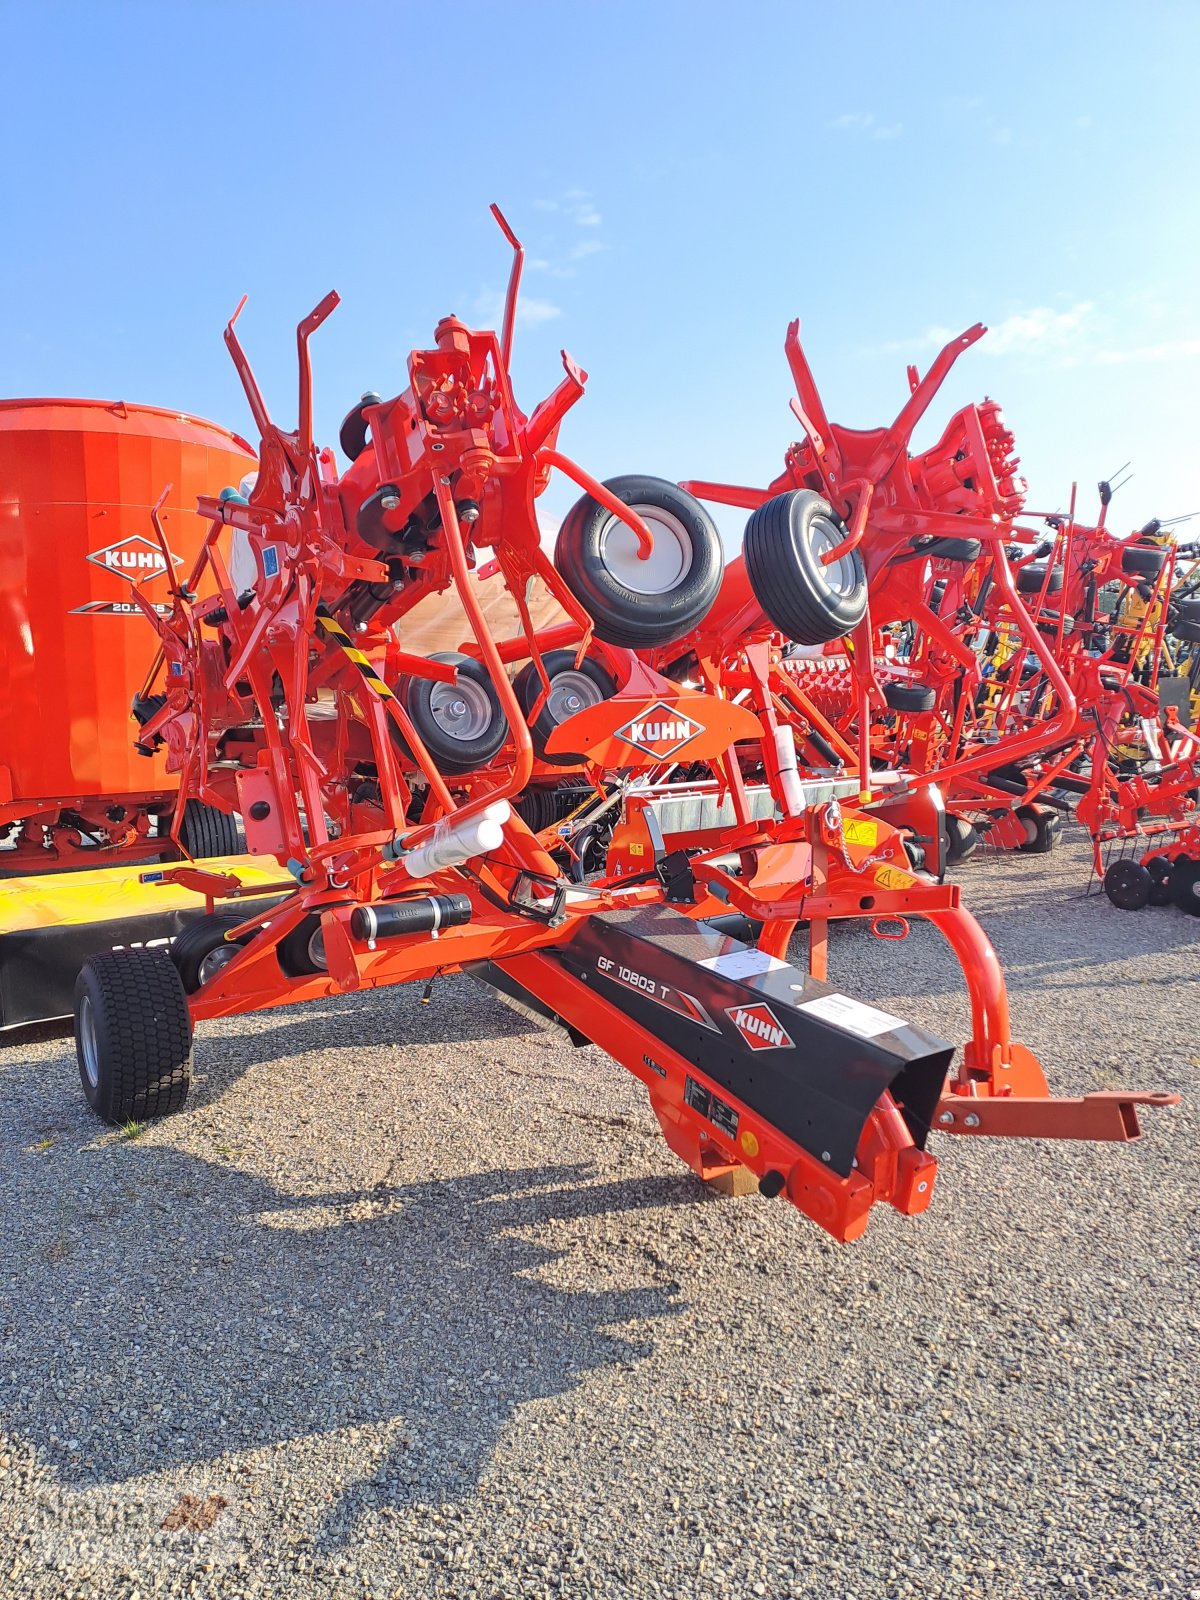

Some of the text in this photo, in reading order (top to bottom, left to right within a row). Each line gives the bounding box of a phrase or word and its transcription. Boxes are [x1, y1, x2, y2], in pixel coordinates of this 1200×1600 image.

[105, 550, 168, 568] KUHN
[631, 721, 691, 742] KUHN
[597, 956, 670, 1000] GF 10803 T
[735, 1009, 784, 1047] KUHN
